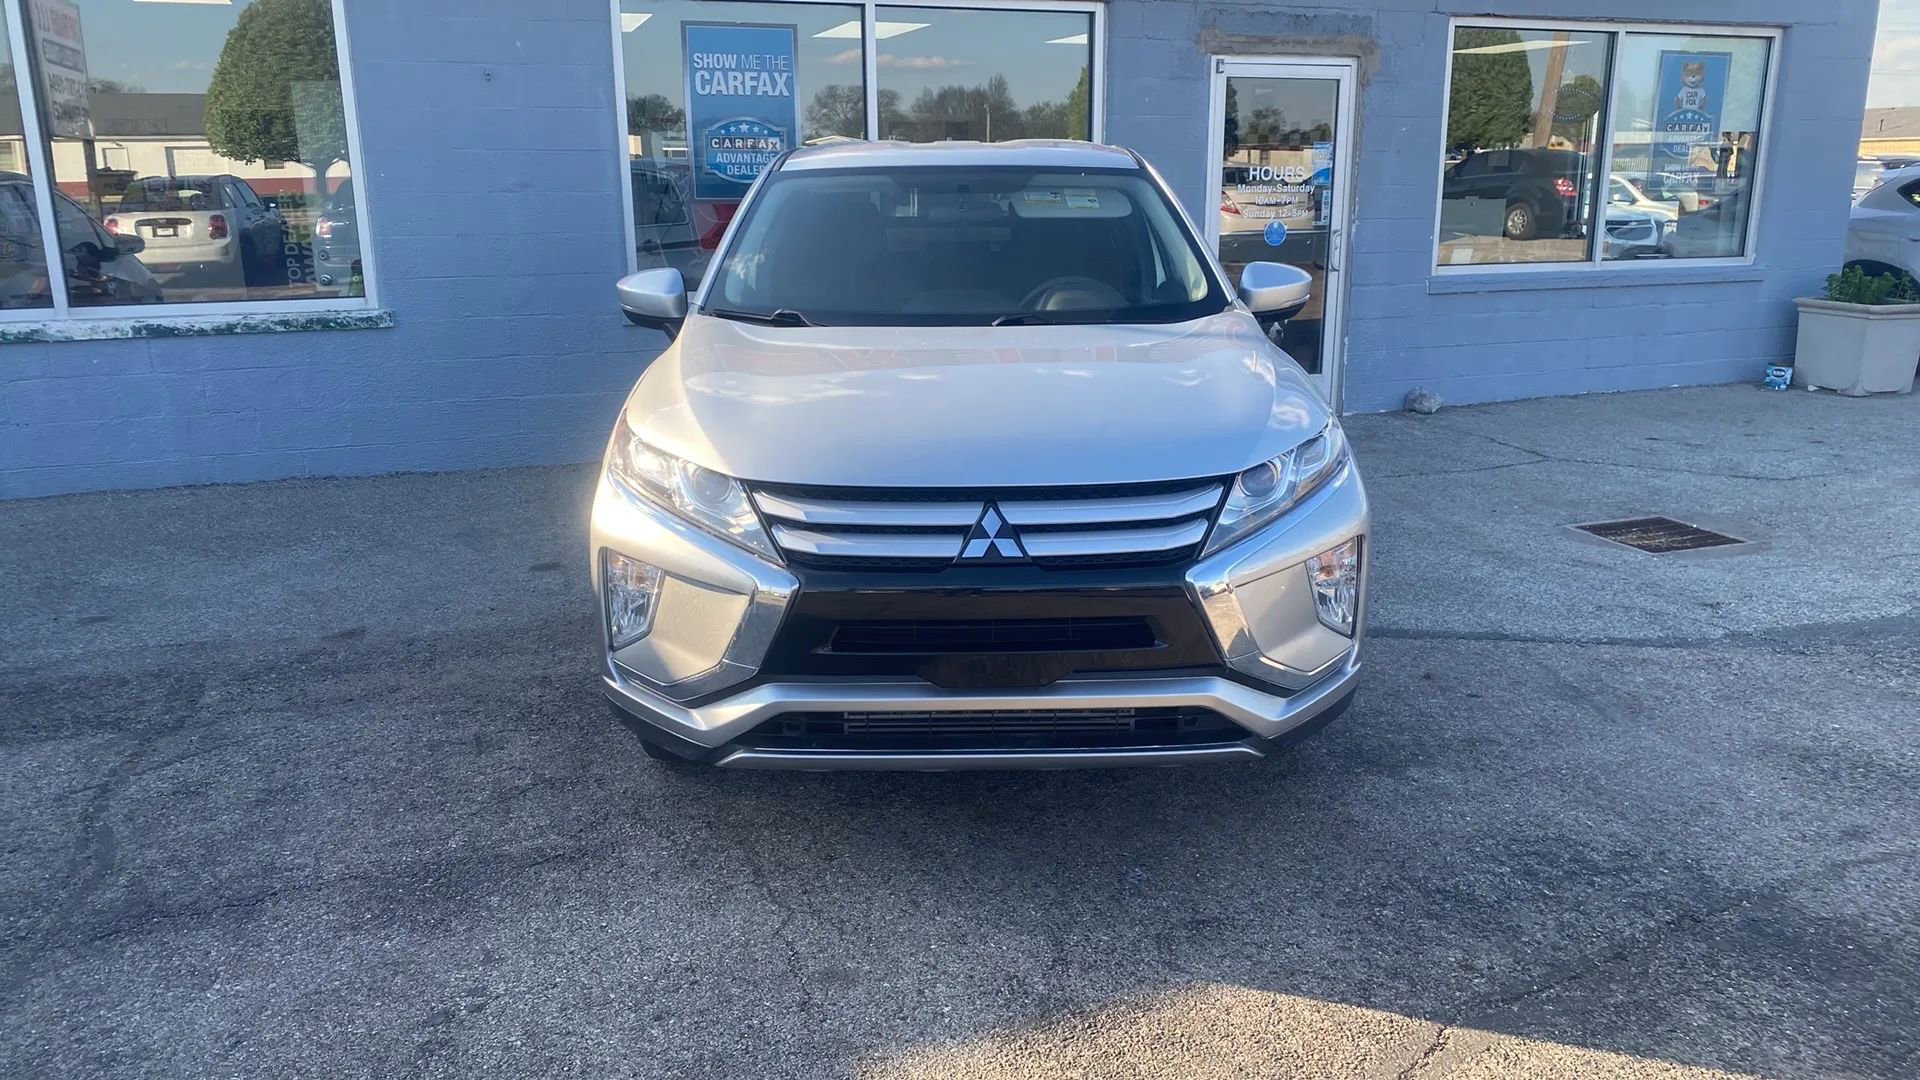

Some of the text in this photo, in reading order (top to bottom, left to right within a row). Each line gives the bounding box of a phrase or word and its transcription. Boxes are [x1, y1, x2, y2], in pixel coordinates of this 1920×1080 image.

[693, 53, 789, 71] SHOW ME THE
[695, 70, 791, 97] CARFAX
[1685, 91, 1698, 99] CAR
[1666, 123, 1711, 133] CARFAX
[711, 138, 779, 150] CARFAX
[1249, 166, 1305, 181] HOURS
[1237, 183, 1316, 194] Monday-Saturday
[1255, 196, 1298, 205] 10AM-7PM
[1243, 208, 1309, 219] Sunday 12-5PM
[285, 258, 302, 288] TOP
